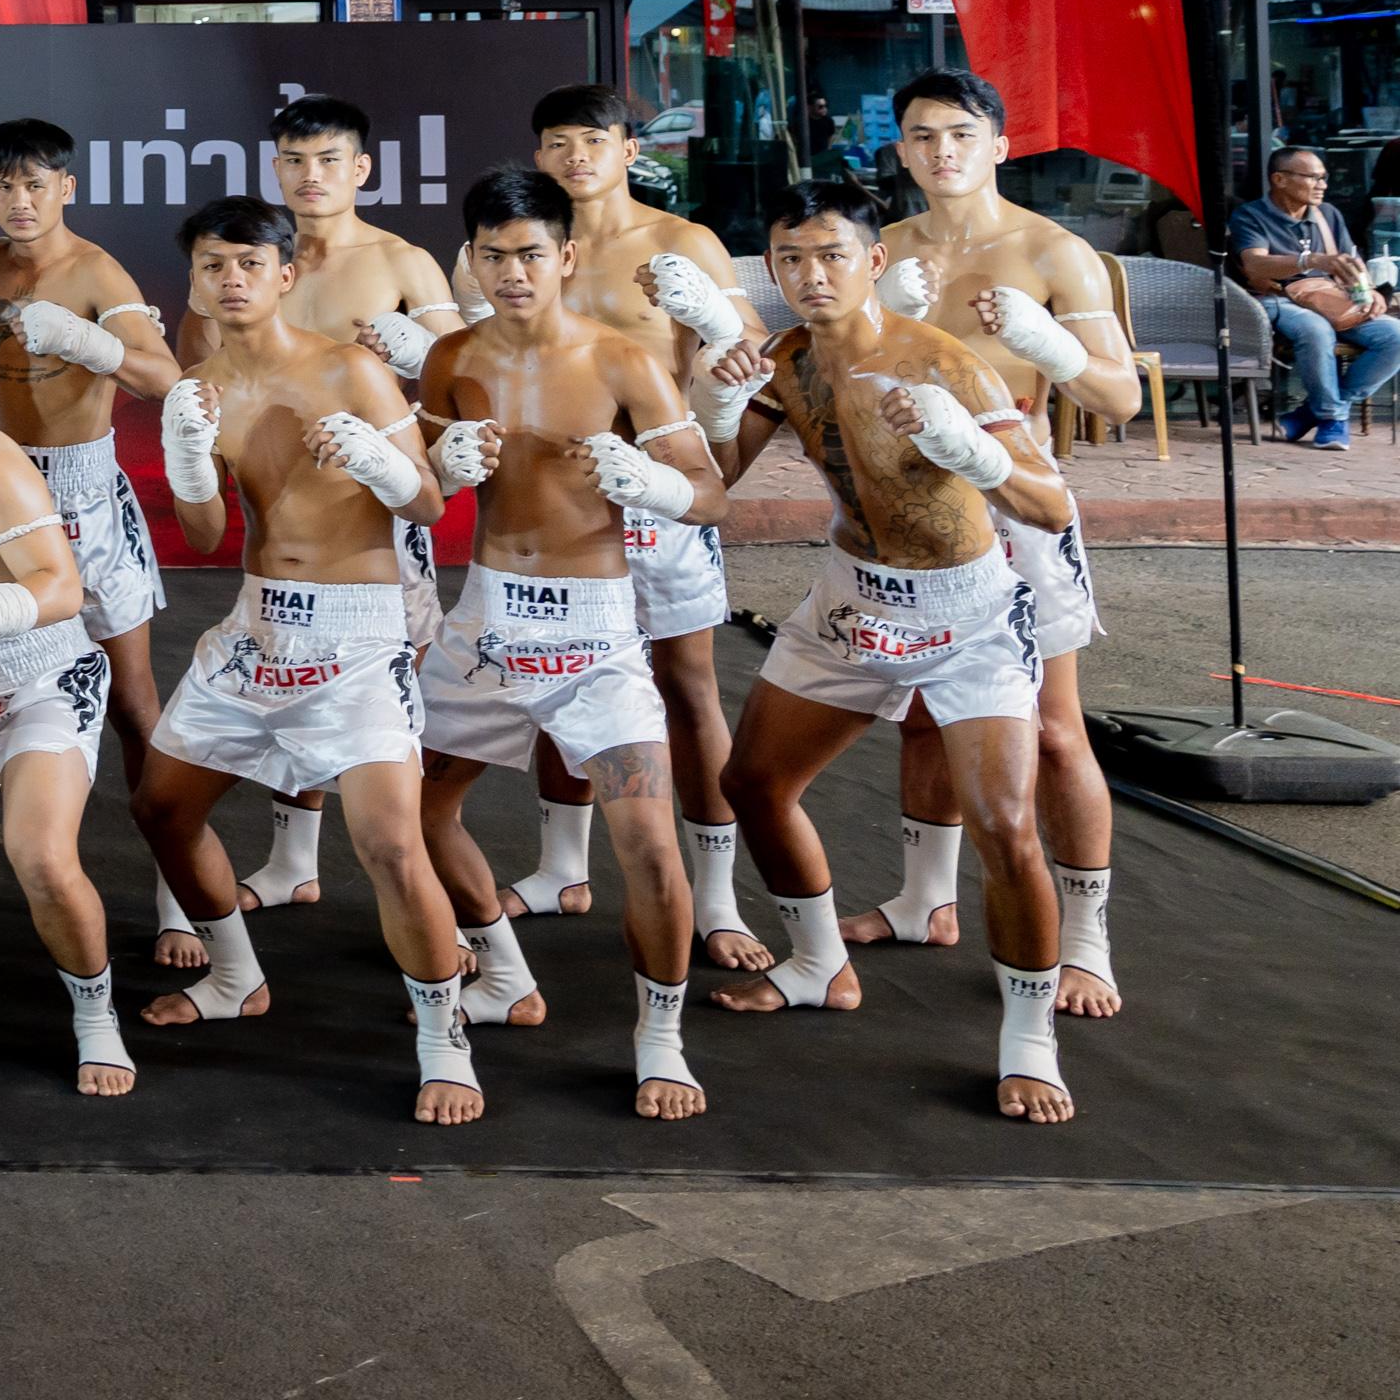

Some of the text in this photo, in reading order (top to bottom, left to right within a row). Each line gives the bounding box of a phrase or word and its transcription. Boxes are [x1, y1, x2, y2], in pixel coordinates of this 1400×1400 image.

[854, 566, 914, 594] THAI
[261, 588, 315, 612] THAI
[504, 582, 568, 605] THAI
[261, 606, 314, 622] FIGHT
[506, 602, 569, 616] FIGHT
[856, 616, 926, 641] THAILA
[504, 642, 610, 654] THAILAND
[851, 628, 952, 656] ISUZU
[1061, 876, 1105, 889] THAI
[646, 986, 680, 1004] THA
